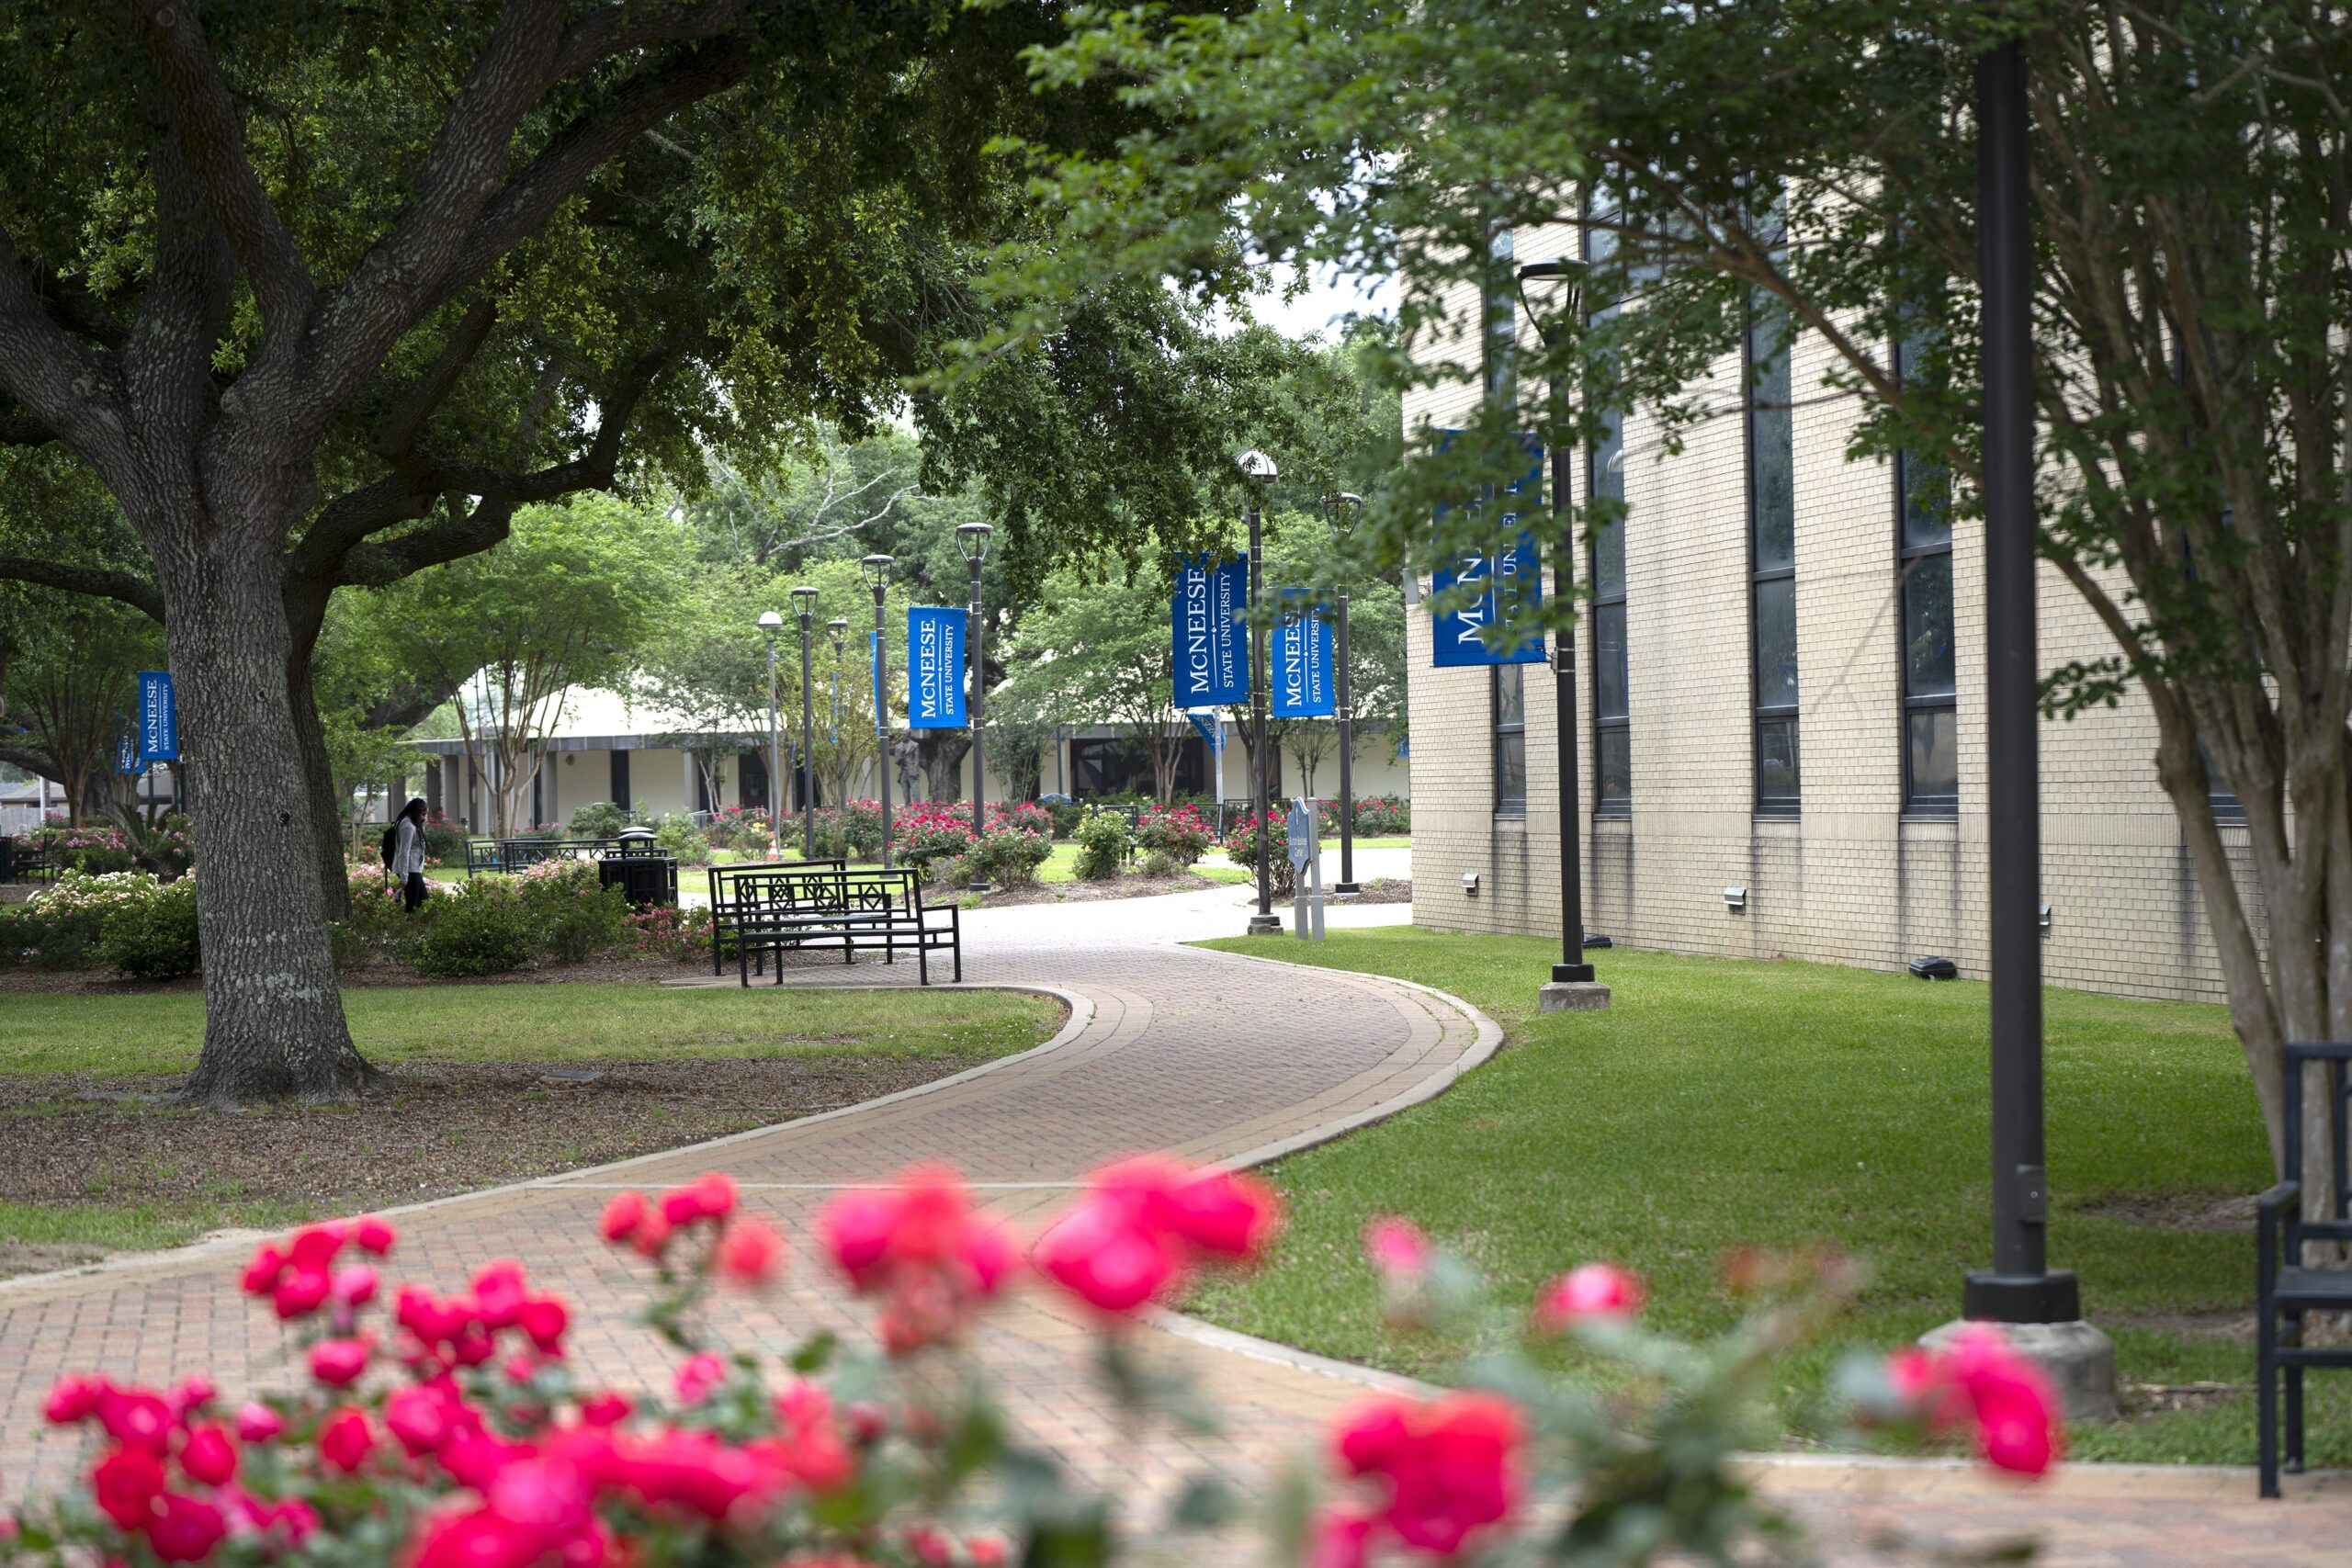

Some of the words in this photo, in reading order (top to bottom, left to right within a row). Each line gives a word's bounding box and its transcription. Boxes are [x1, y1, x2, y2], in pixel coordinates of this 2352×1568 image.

[1219, 571, 1232, 647] UNIVERSITY
[944, 624, 954, 682] UNIVERSITY
[1221, 649, 1234, 688] STATE
[944, 684, 955, 715] STATE
[1311, 671, 1321, 704] STATE
